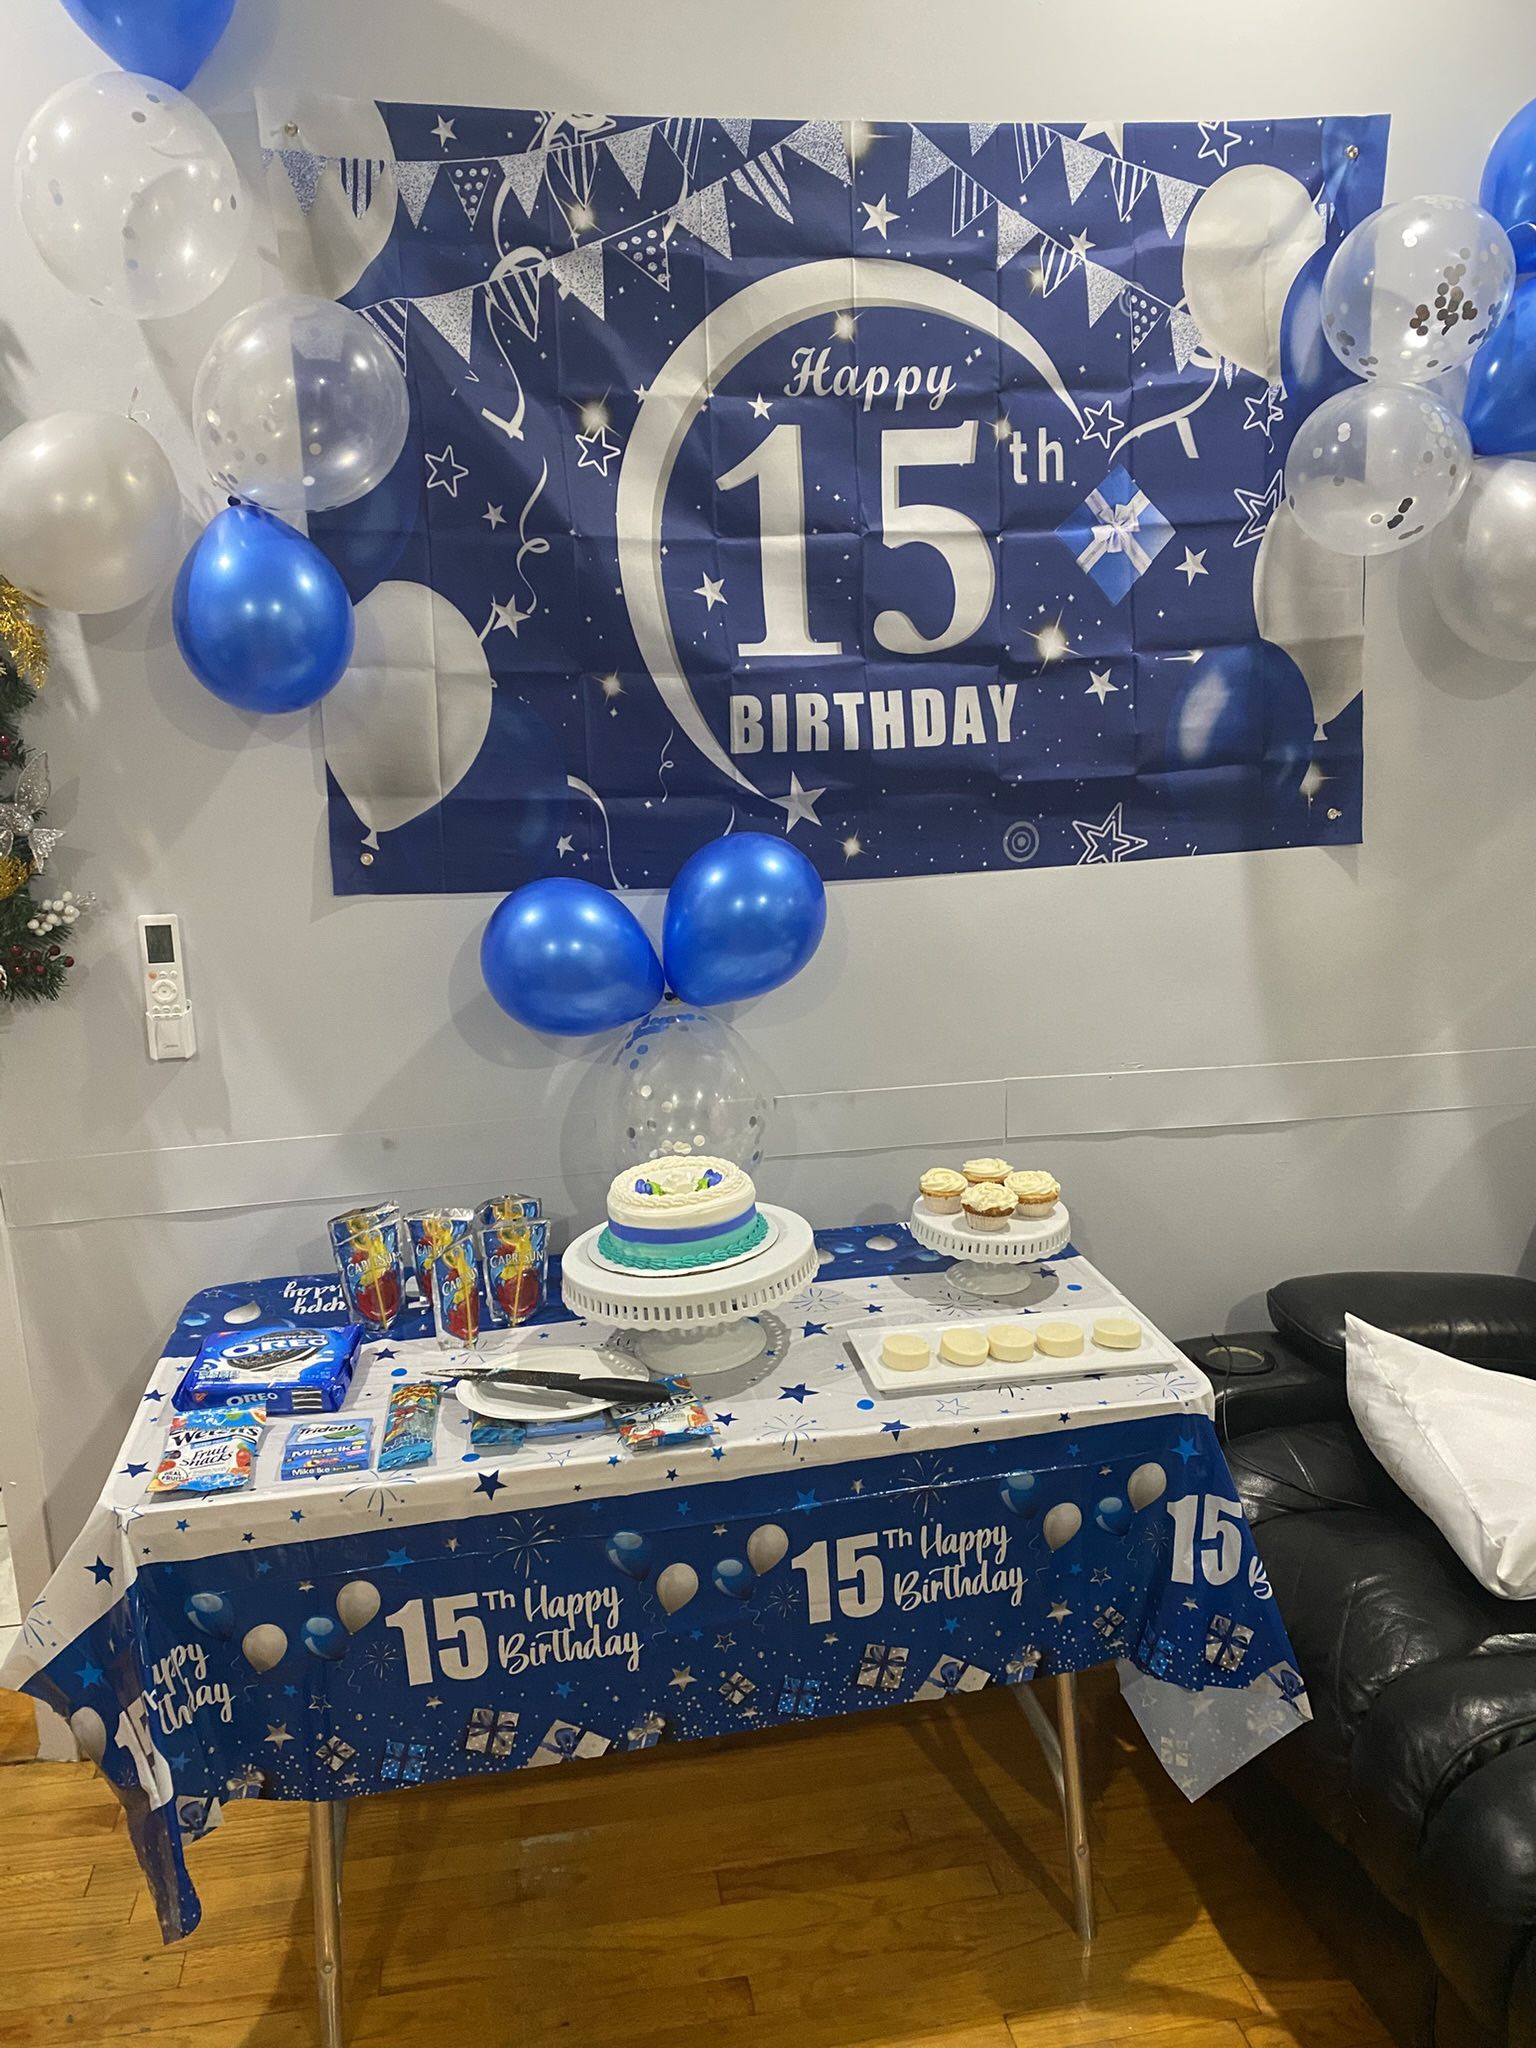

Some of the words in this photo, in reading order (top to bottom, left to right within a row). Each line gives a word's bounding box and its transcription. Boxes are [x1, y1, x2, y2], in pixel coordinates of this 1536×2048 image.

[783, 346, 957, 412] Happy
[730, 684, 1018, 755] BIRTHDAY
[221, 1338, 330, 1358] OREO
[226, 1391, 279, 1407] OREO
[299, 1423, 356, 1435] Trident
[179, 1451, 234, 1468] Snacks
[193, 1445, 230, 1460] Fruit
[291, 1447, 333, 1458] Mike
[291, 1467, 315, 1477] Mike
[920, 1523, 1013, 1566] Happy
[894, 1559, 1029, 1611] Birthday
[523, 1584, 624, 1630] Happy
[498, 1624, 645, 1675] Birthday
